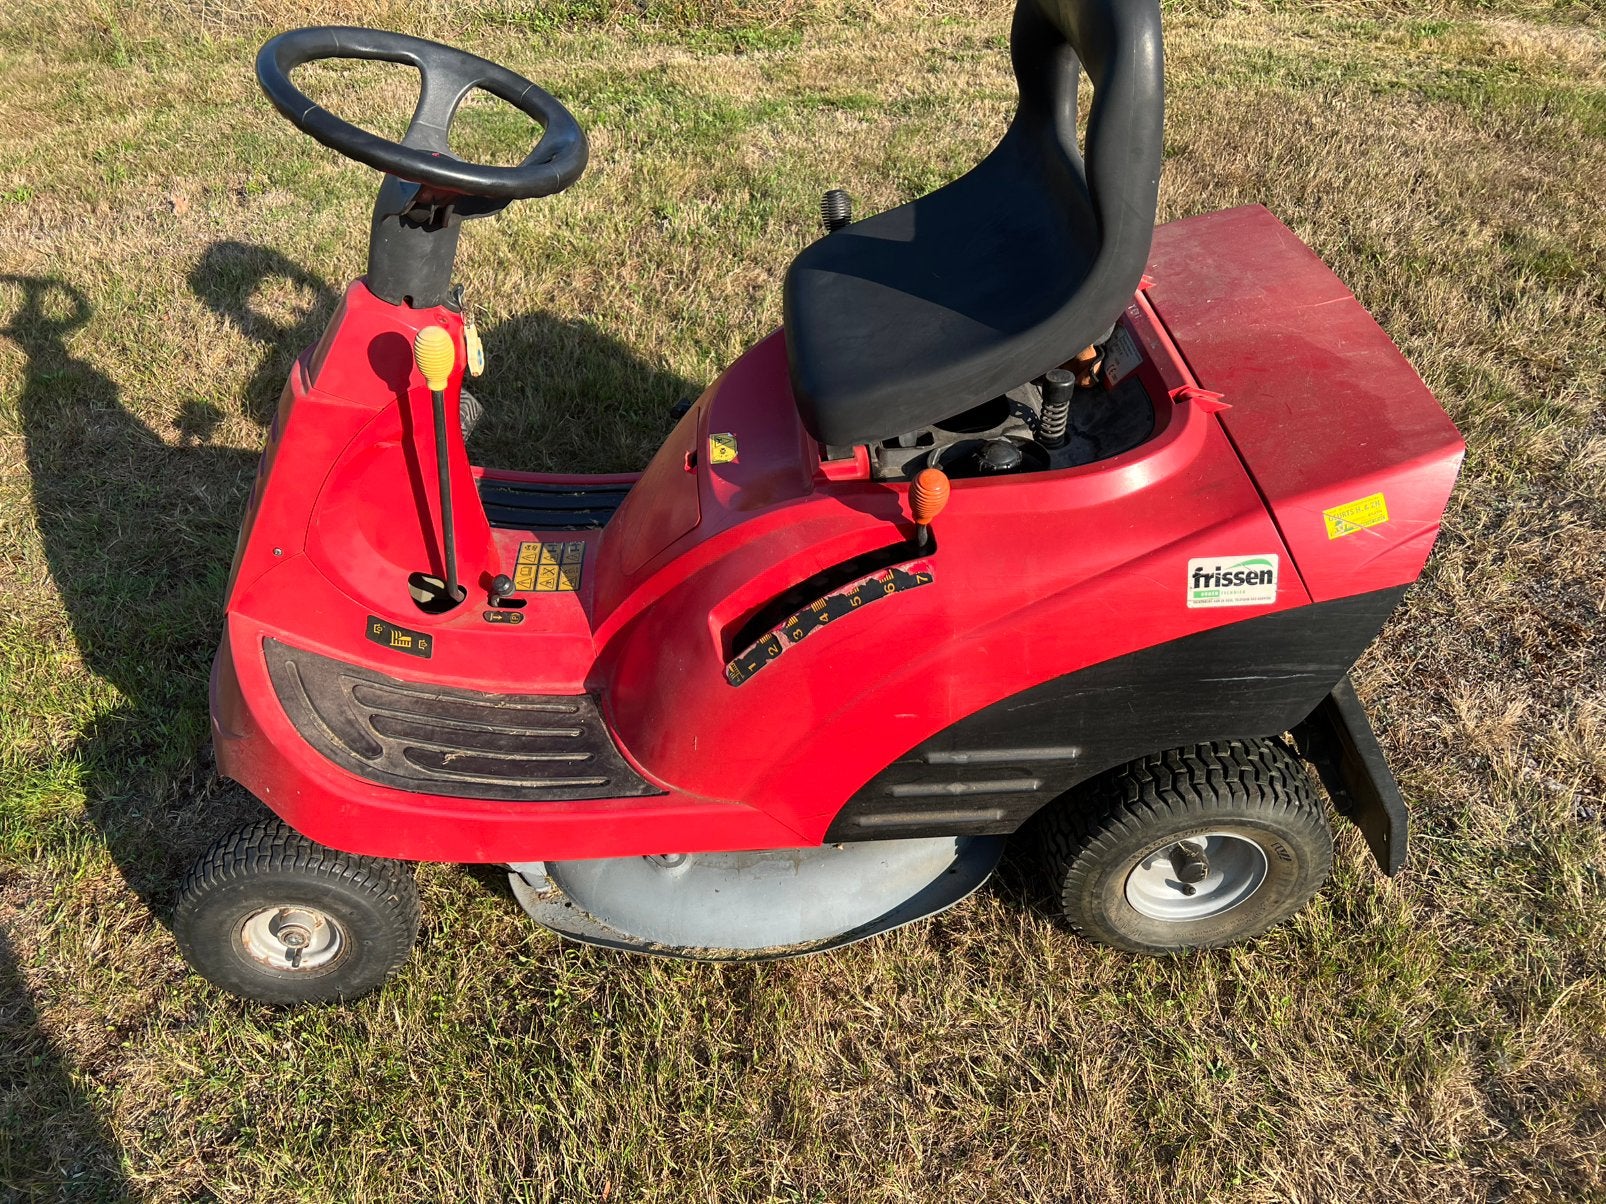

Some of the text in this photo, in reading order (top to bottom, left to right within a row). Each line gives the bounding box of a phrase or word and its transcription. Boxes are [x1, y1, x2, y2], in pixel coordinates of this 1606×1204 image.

[1192, 566, 1273, 588] frissen
[748, 575, 929, 671] 1 2 3 4 5 6 7
